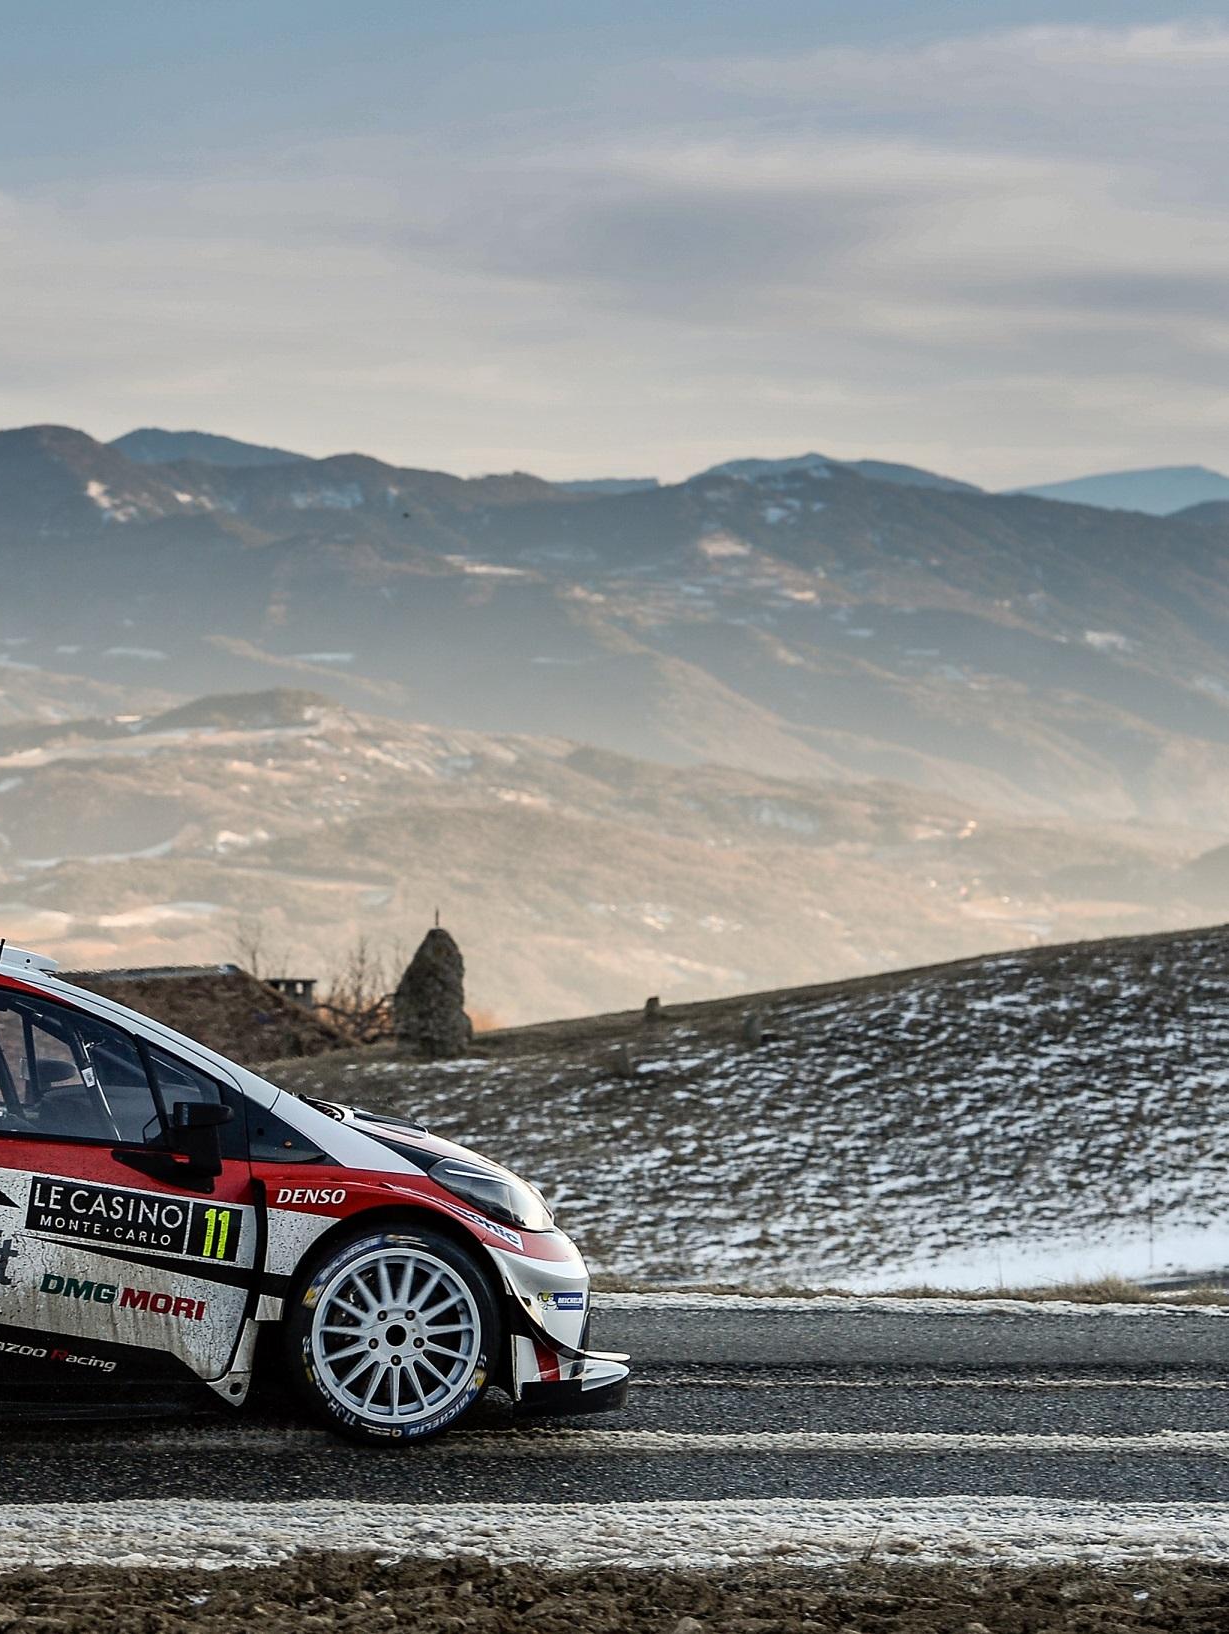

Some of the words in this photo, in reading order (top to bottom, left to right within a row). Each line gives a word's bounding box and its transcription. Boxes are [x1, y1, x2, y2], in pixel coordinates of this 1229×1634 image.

[33, 1183, 65, 1210] LE
[70, 1190, 184, 1229] CASINO
[275, 1188, 347, 1205] DENSO
[202, 1208, 231, 1259] 11
[39, 1273, 118, 1304] DMG
[120, 1287, 207, 1321] MORI
[49, 1349, 117, 1372] Racing
